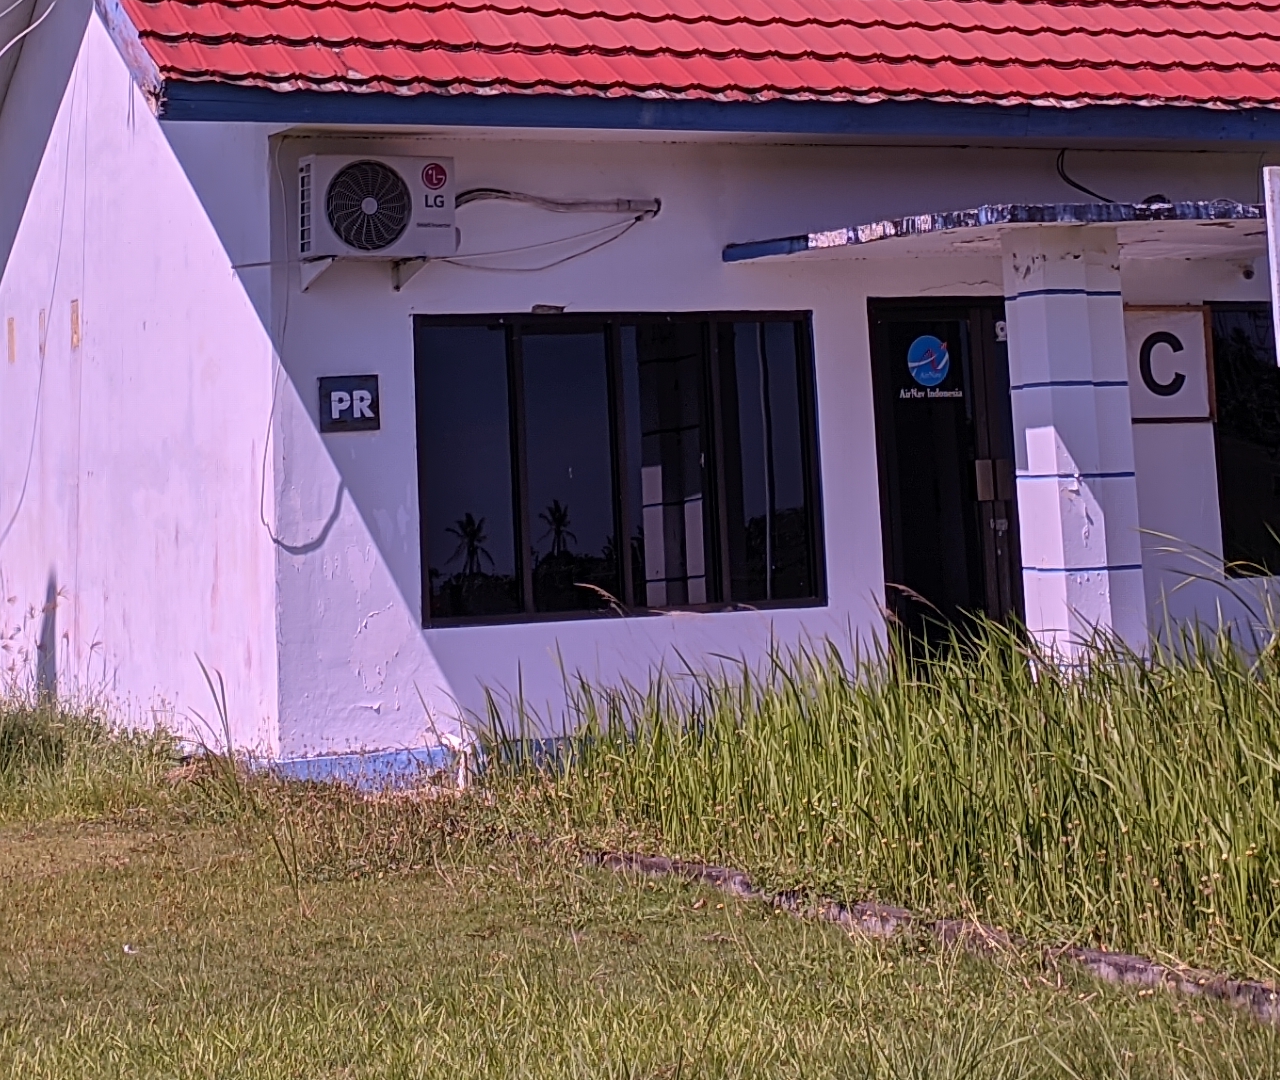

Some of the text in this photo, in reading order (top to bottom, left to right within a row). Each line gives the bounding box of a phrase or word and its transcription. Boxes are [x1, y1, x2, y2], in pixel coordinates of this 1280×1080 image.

[425, 194, 445, 208] LG
[1139, 331, 1186, 396] C
[926, 387, 964, 398] Indonesia
[330, 389, 375, 419] PR
